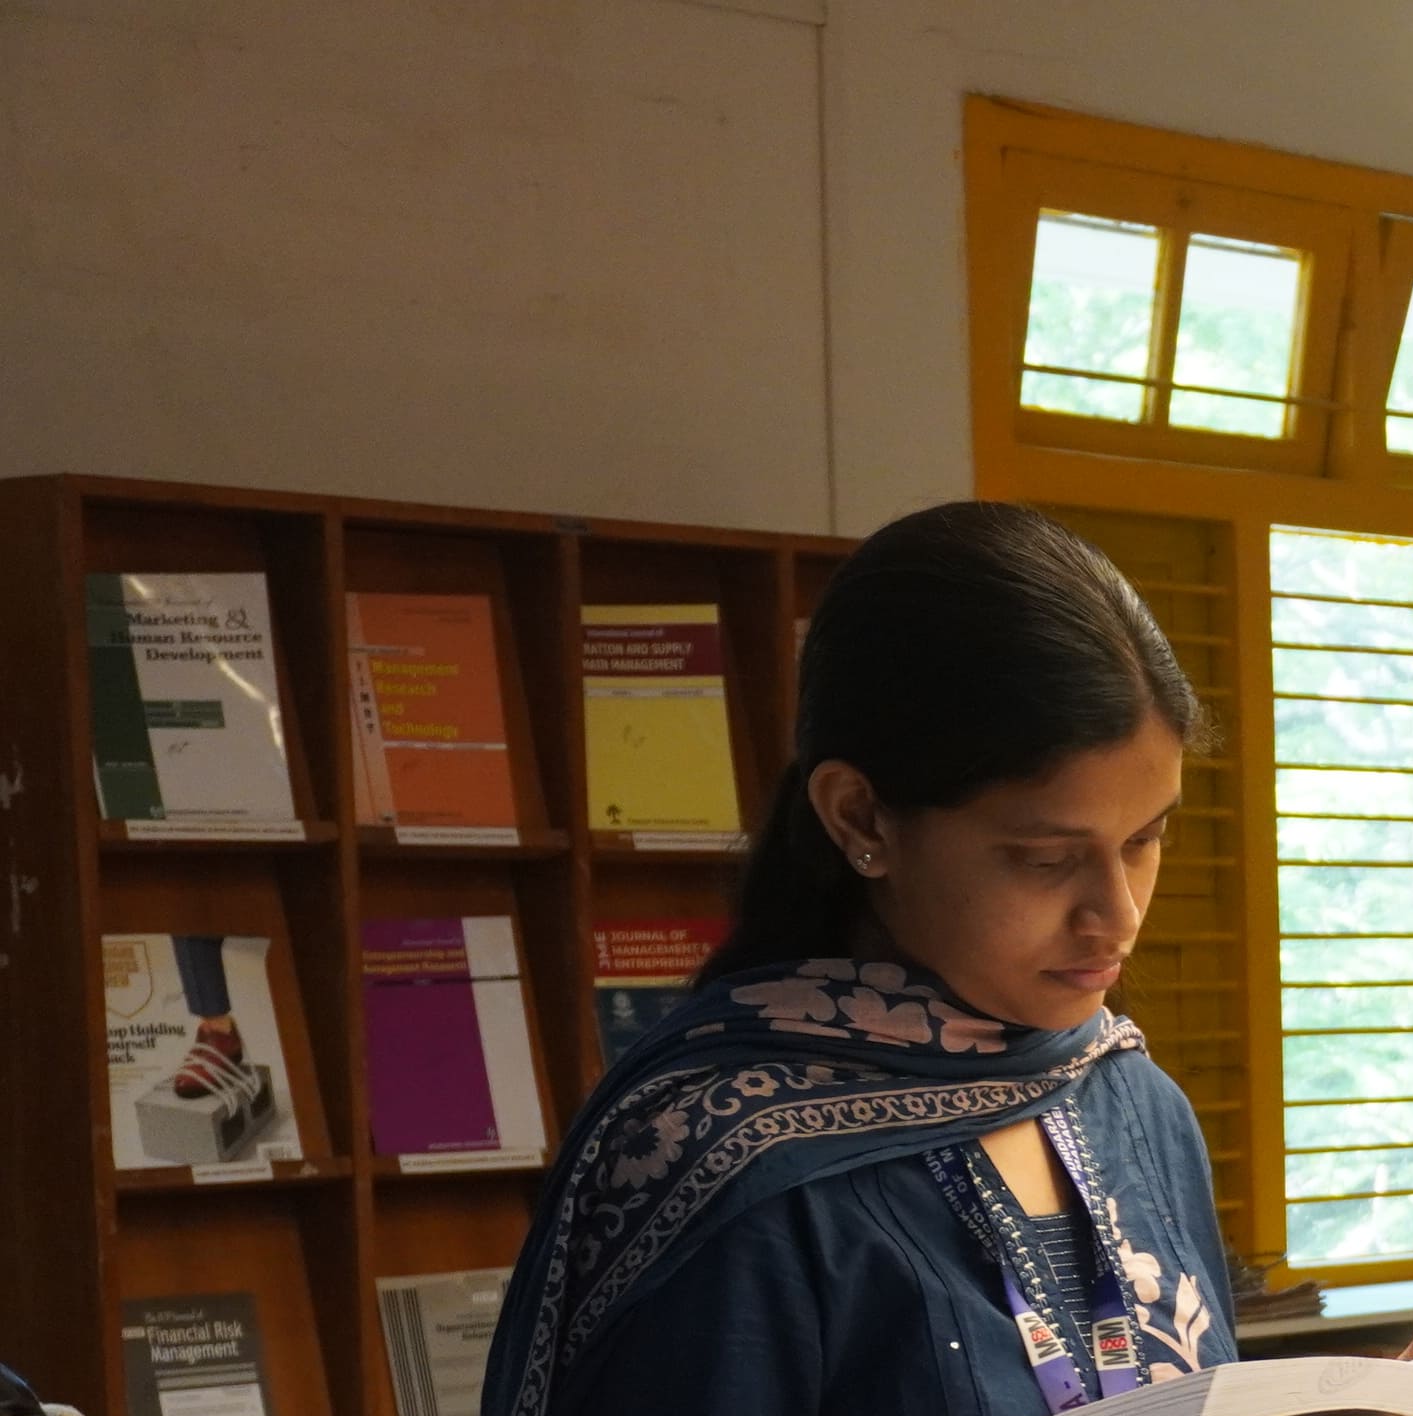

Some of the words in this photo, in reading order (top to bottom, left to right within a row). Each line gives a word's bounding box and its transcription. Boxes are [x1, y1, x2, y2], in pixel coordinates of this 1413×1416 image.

[126, 611, 218, 629] Marketing
[147, 1325, 211, 1343] Financial
[213, 1321, 242, 1339] Risk
[151, 1341, 238, 1364] Management
